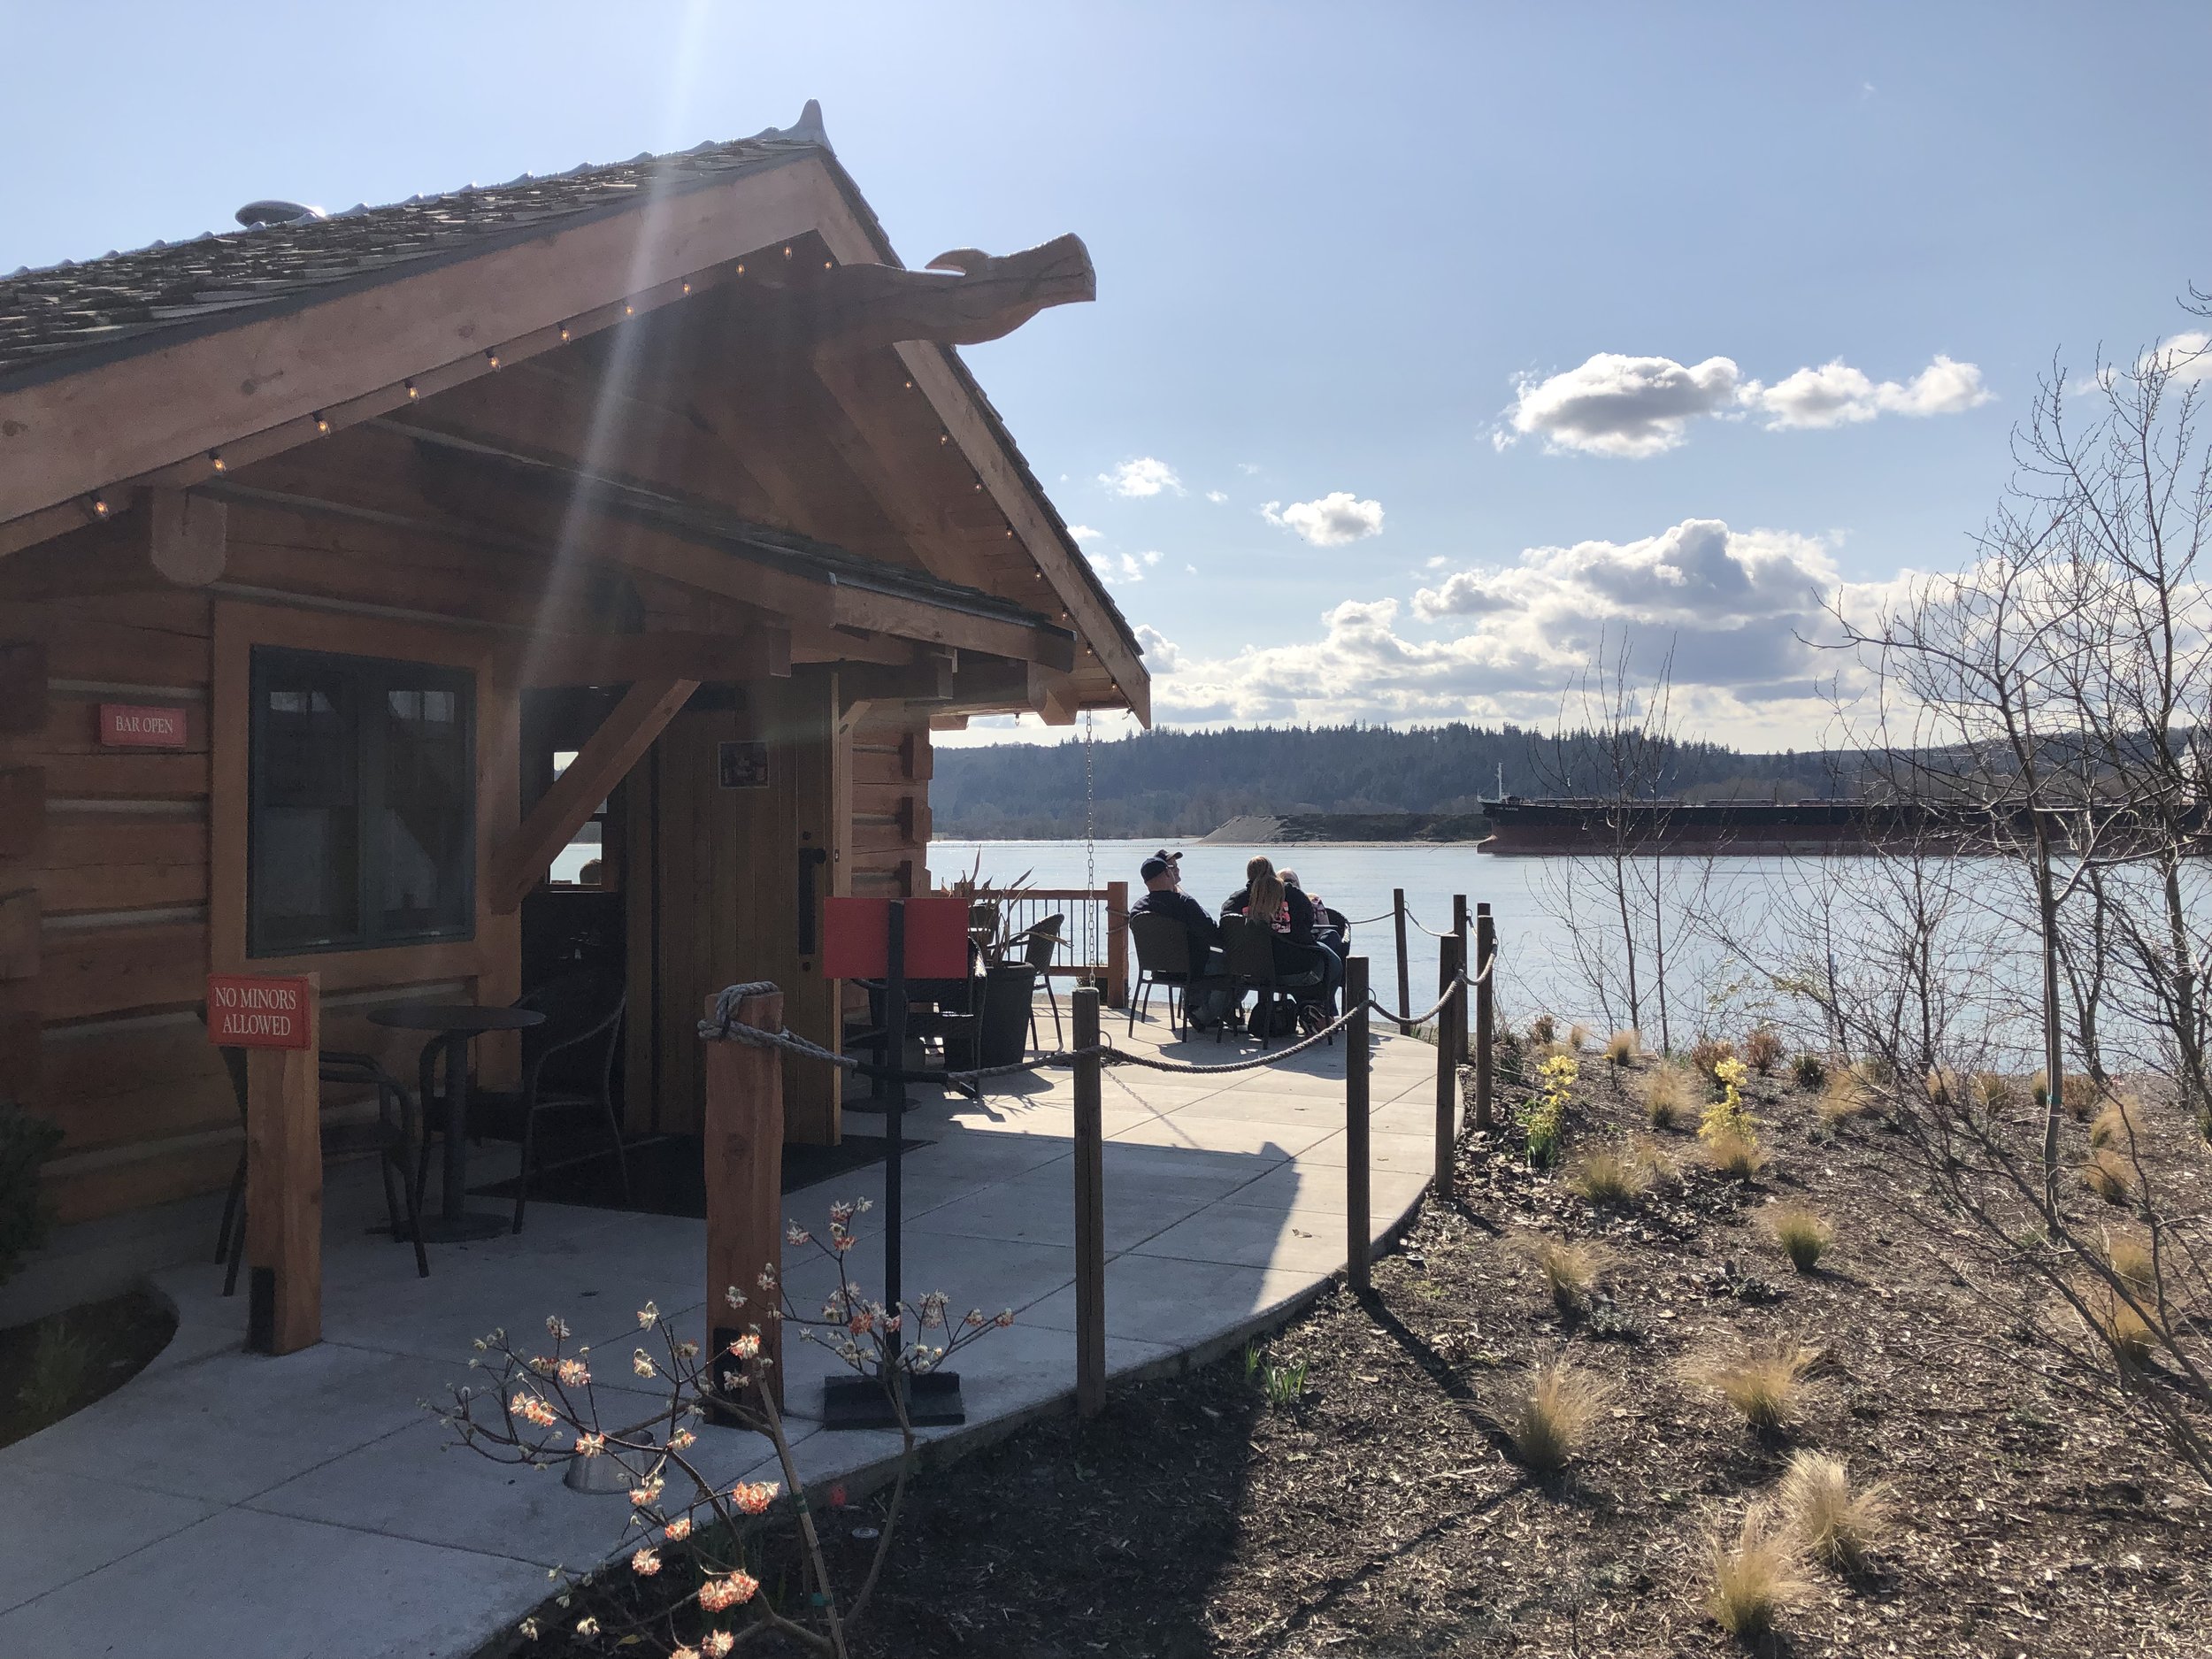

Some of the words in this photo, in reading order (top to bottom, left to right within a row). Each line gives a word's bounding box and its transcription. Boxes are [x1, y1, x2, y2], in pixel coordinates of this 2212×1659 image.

[116, 715, 141, 733] BAR
[142, 718, 173, 733] OPEN
[215, 987, 237, 1008] NO
[240, 988, 296, 1010] MINORS
[223, 1014, 291, 1036] ALLOWED
